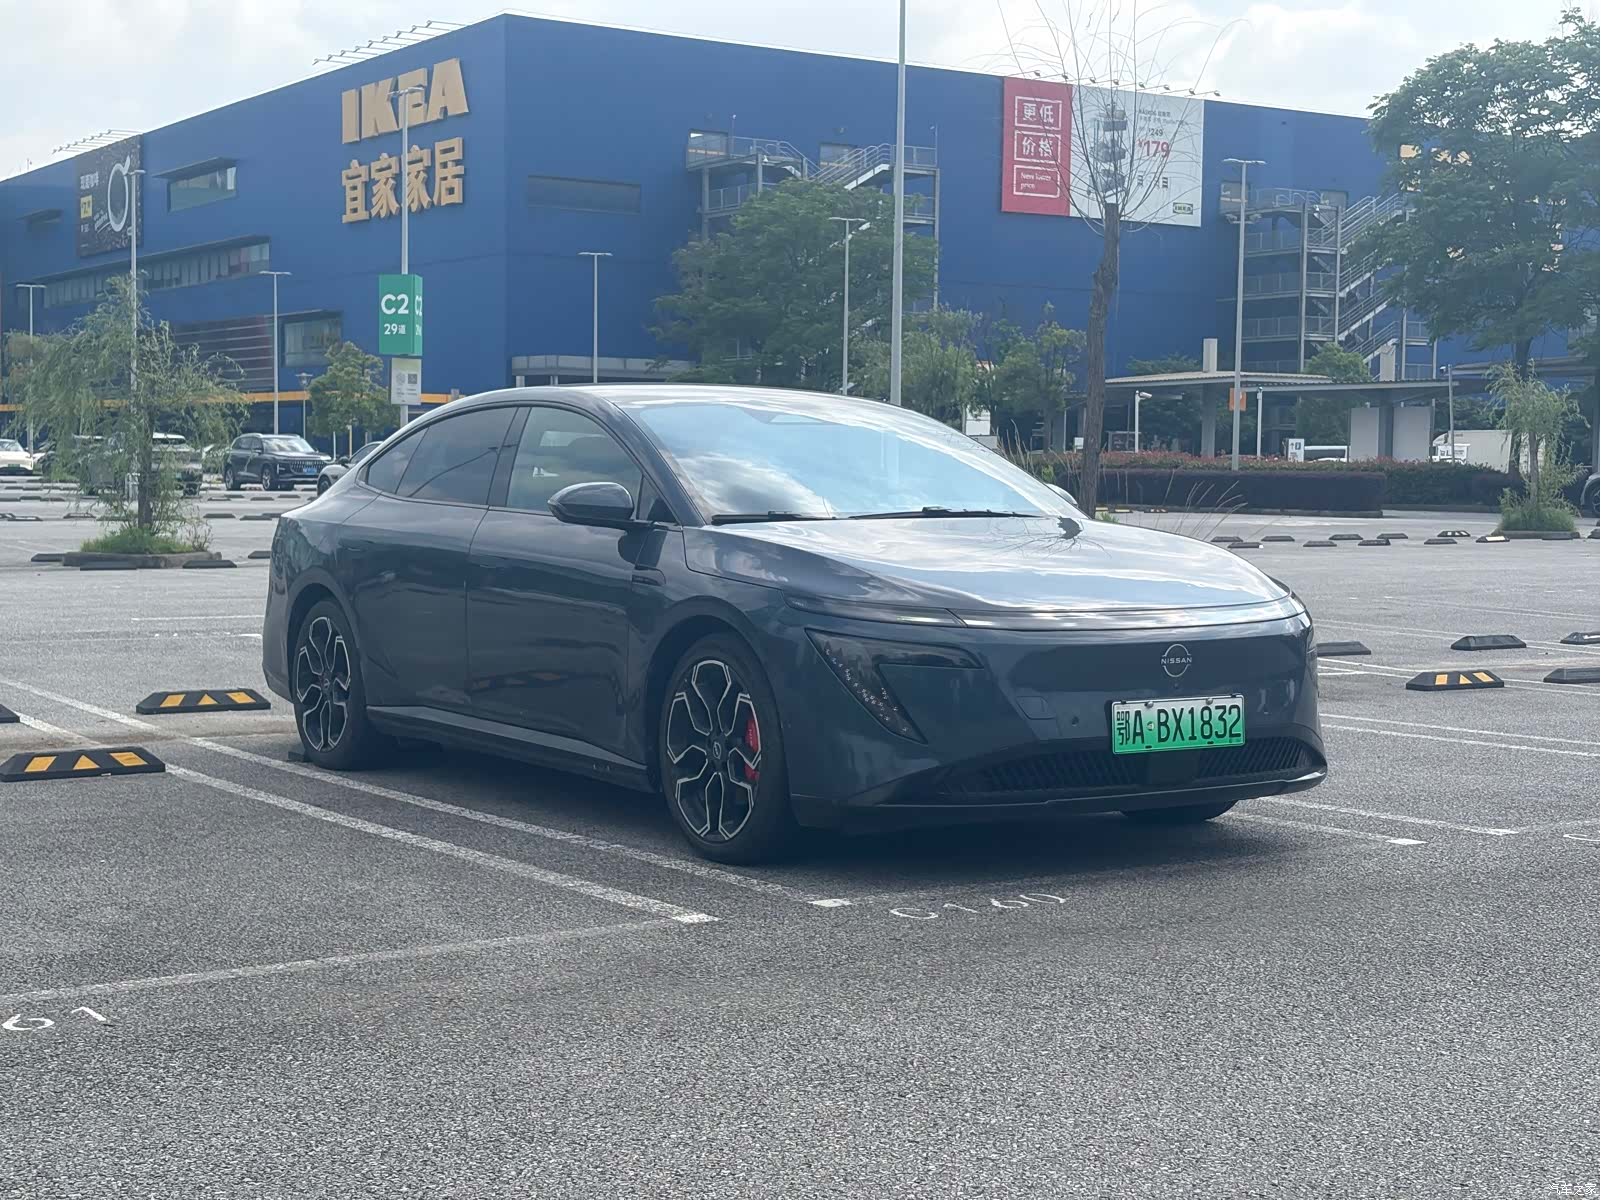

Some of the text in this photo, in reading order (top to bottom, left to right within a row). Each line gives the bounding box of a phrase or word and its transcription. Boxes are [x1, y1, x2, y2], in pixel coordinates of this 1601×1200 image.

[341, 57, 469, 144] IKEA
[1022, 103, 1055, 123] 更低
[1021, 137, 1054, 157] 价格
[341, 137, 464, 223] 宜家家居
[380, 293, 409, 315] C2
[1161, 656, 1192, 665] NISSAN
